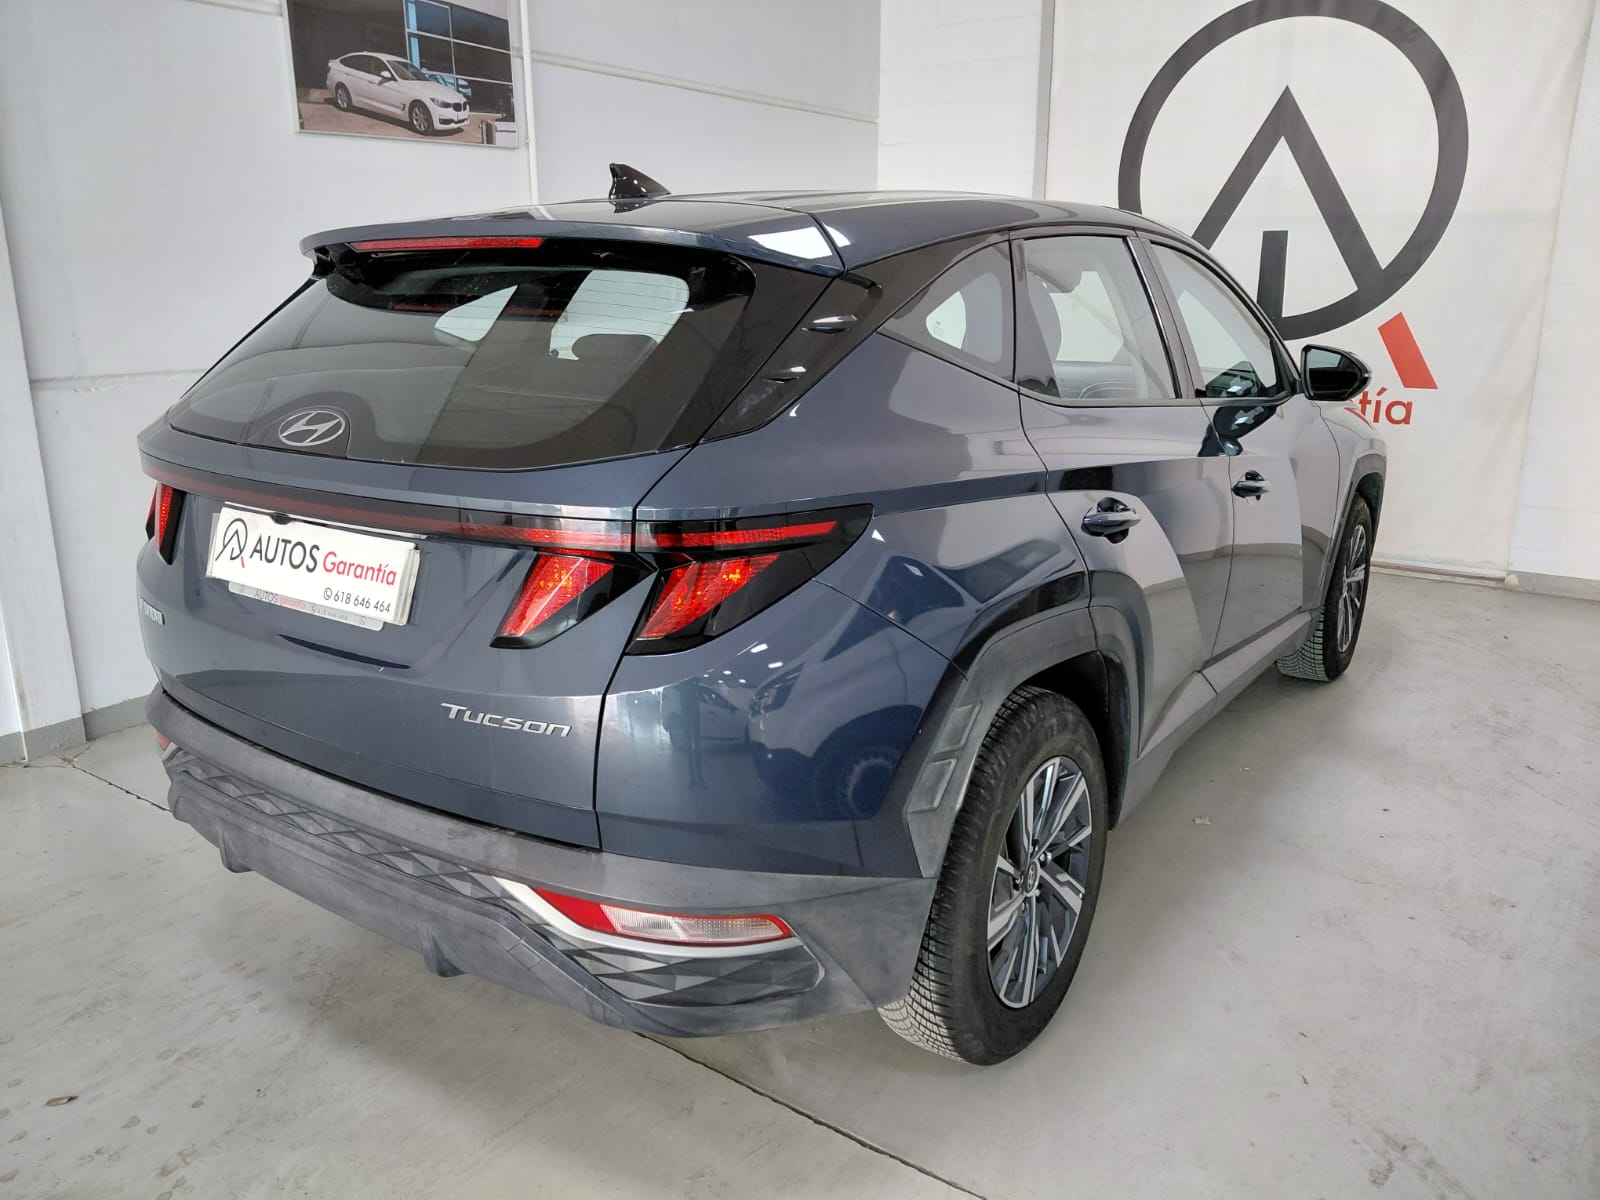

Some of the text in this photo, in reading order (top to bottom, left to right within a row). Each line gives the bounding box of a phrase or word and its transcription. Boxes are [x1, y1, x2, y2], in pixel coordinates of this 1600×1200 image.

[250, 533, 397, 586] AUTOS Garantía
[333, 589, 391, 613] 618 646 464
